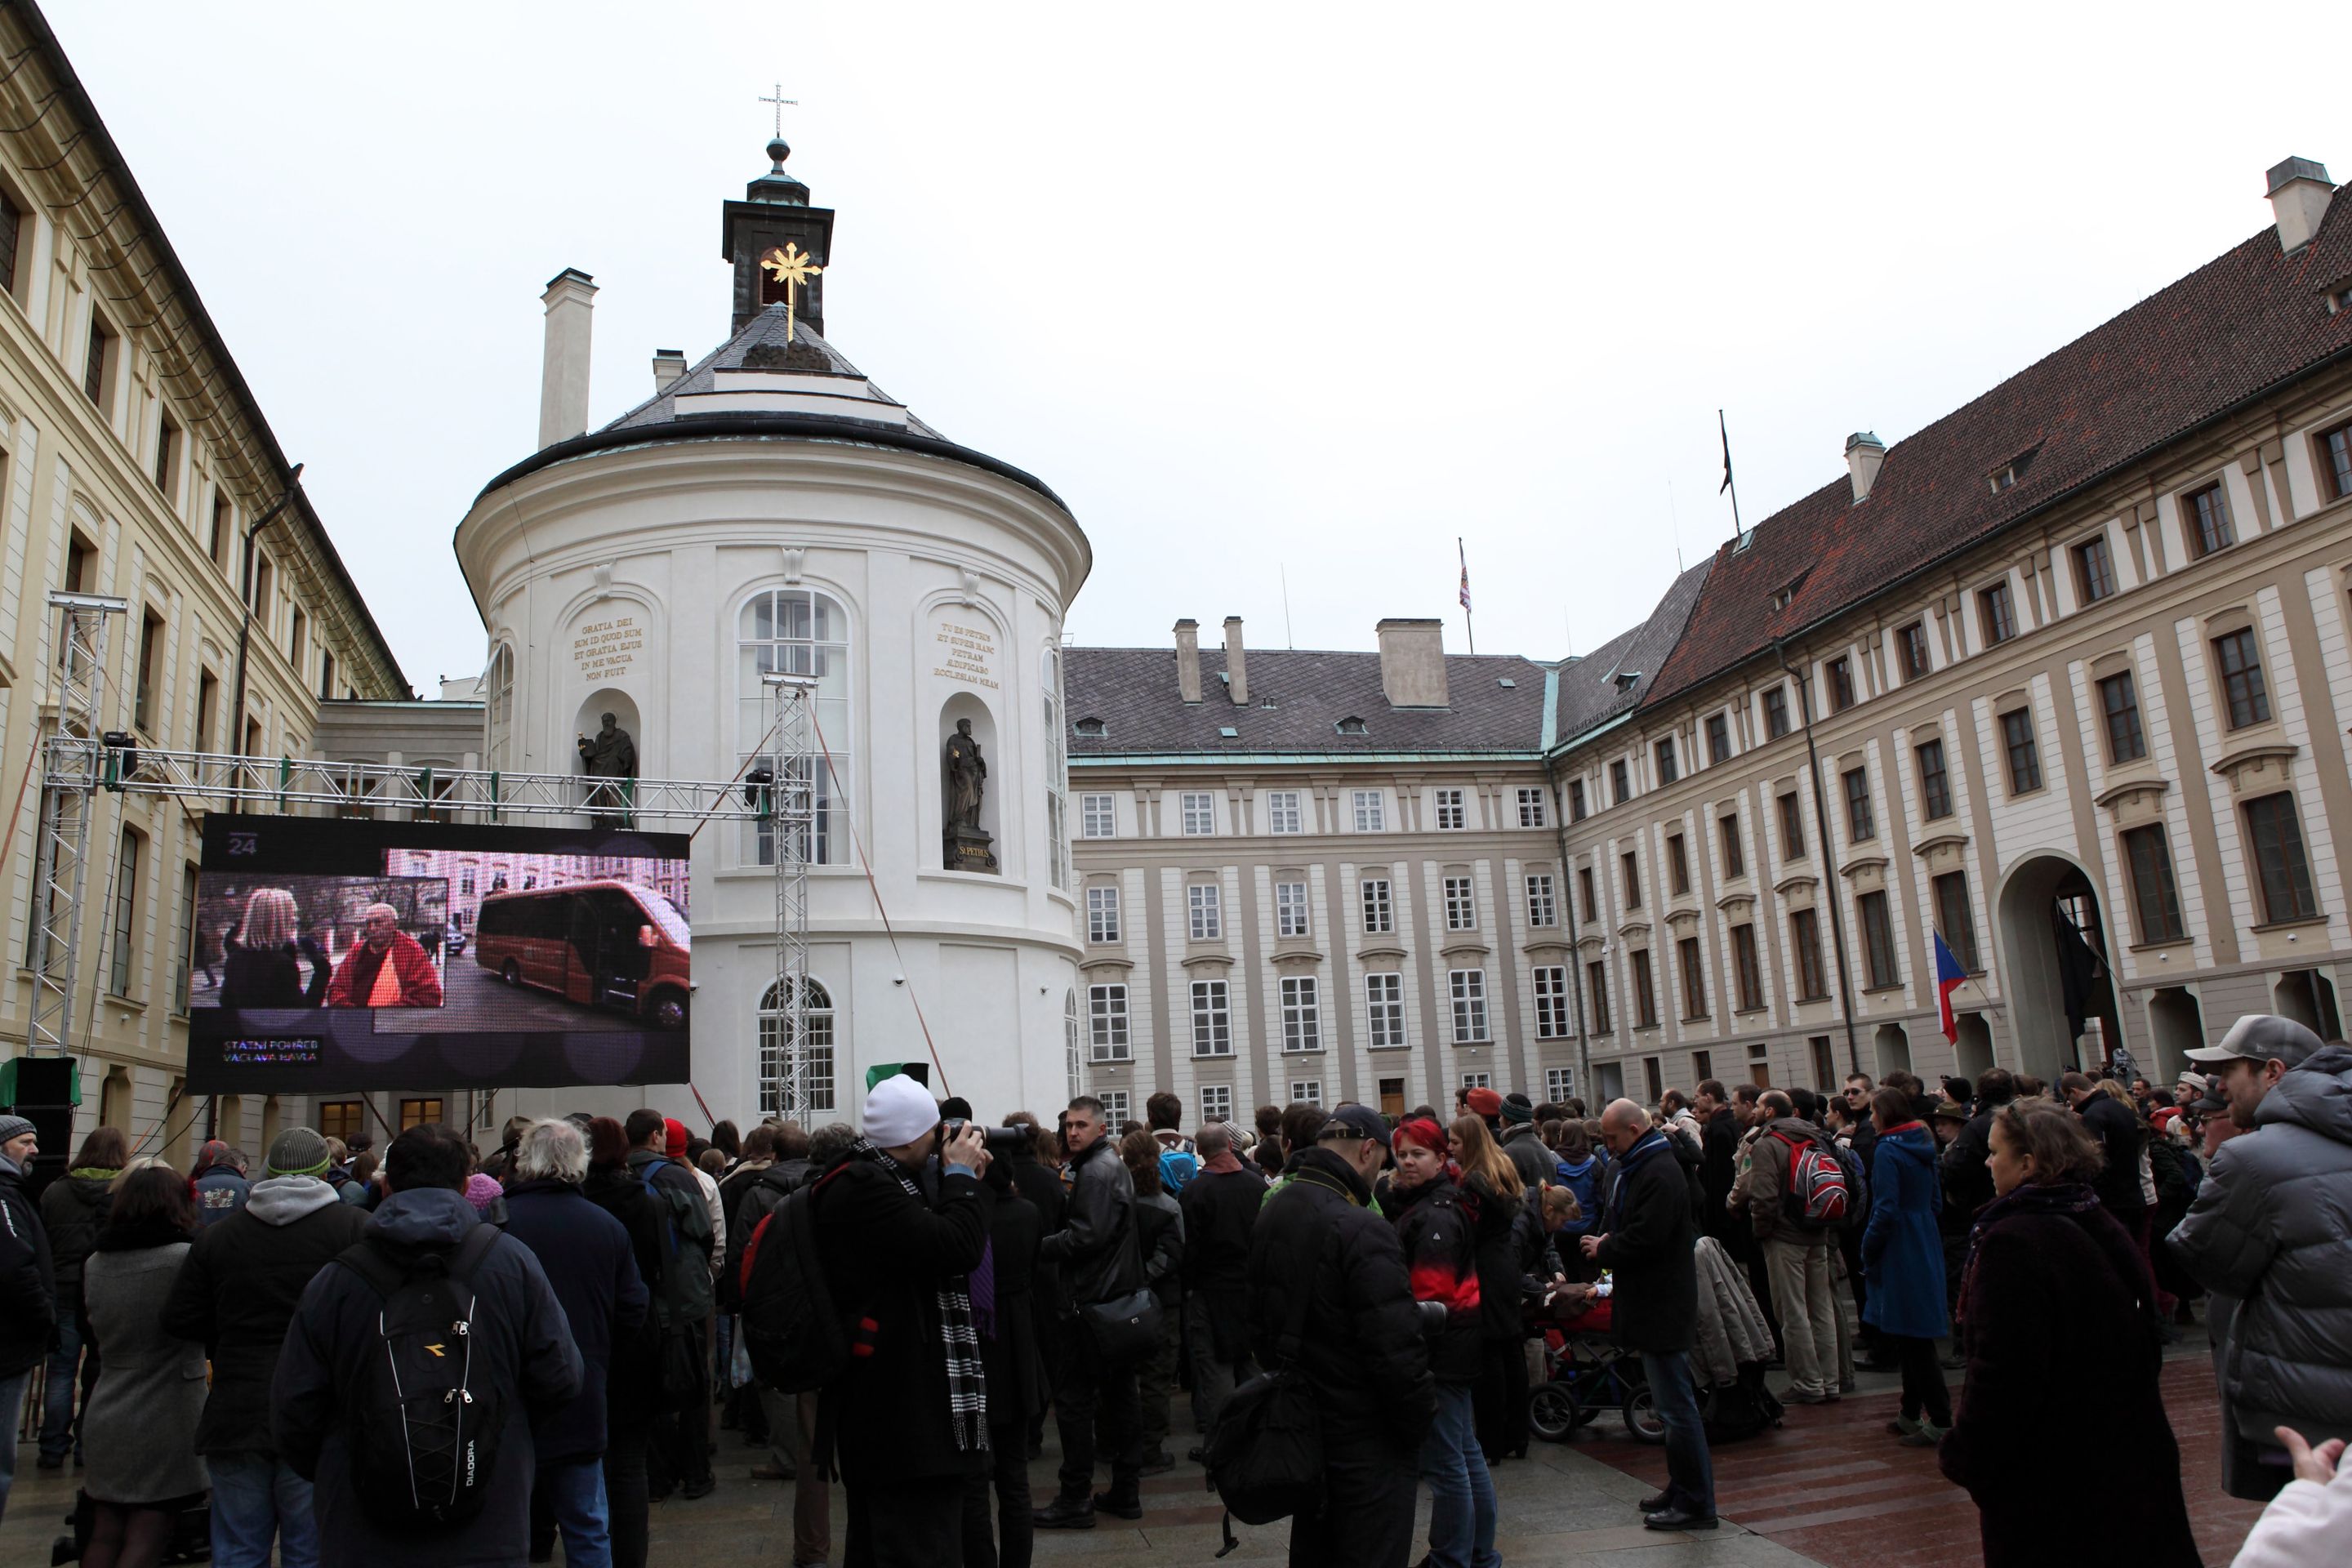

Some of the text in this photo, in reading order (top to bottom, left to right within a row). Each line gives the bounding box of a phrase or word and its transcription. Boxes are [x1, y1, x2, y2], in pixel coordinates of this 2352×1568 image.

[582, 617, 632, 635] GRATIA DEI
[942, 623, 991, 642] TU ES PETRUS
[574, 628, 642, 648] SUM ID QUOD SUM
[937, 634, 995, 654] ET SUPER HANC
[574, 640, 642, 660] ET GRATIA EJUS
[952, 648, 983, 662] PETRAM
[581, 653, 633, 670] IN ME VACUA
[586, 667, 626, 681] NON FUIT
[933, 667, 999, 689] ECCLESIAM MEAM
[229, 838, 256, 856] 24
[466, 1440, 475, 1486] DIADORA
